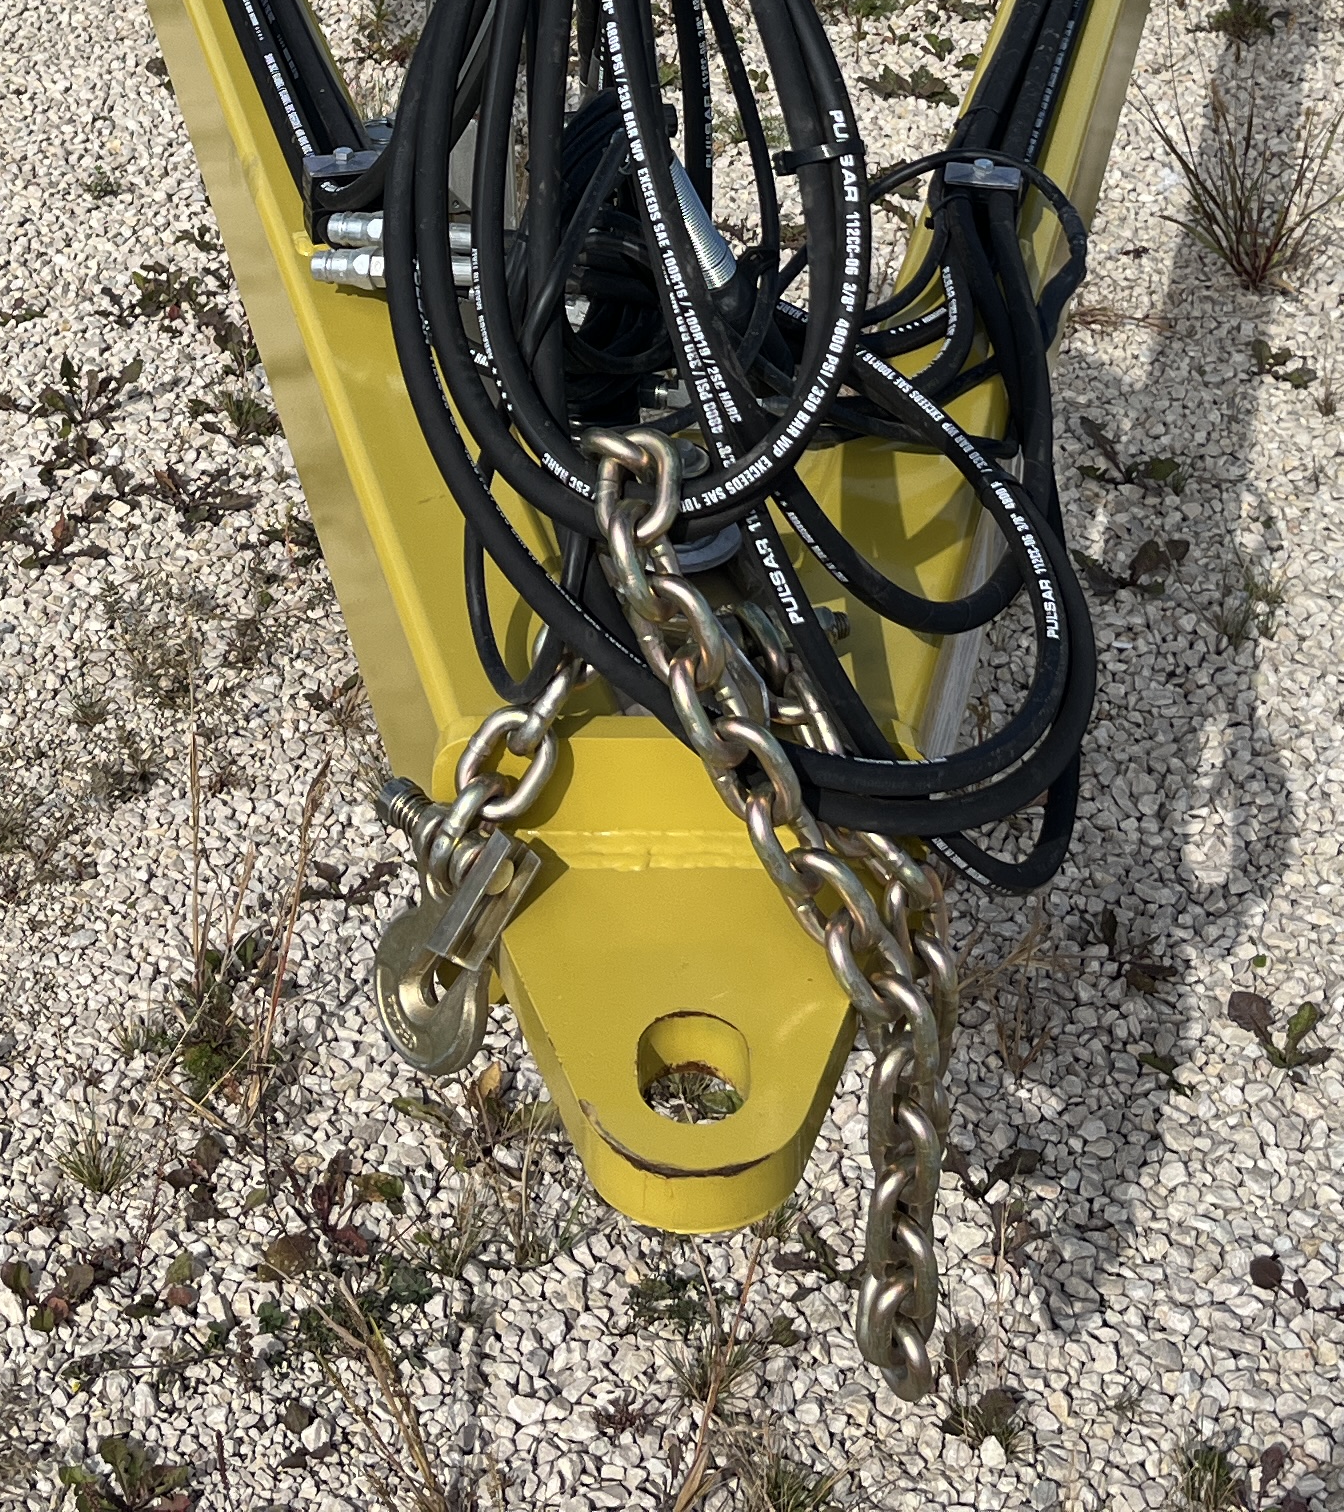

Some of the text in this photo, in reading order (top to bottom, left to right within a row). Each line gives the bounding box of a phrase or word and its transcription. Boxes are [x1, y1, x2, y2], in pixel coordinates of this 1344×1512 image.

[606, 21, 621, 54] 4800
[611, 53, 626, 76] PSI
[617, 84, 633, 111] 330
[623, 111, 639, 139] BAR
[629, 139, 645, 163] WP
[828, 109, 859, 203] PUSAR
[637, 166, 662, 222] EXCEEDS
[652, 222, 671, 249] SAE
[844, 211, 861, 276] 112CC-06
[662, 249, 689, 300] 100R16
[840, 282, 858, 313] 3/8"
[683, 308, 712, 357] 100R19
[828, 317, 851, 354] 4800
[683, 343, 703, 369] 330
[819, 353, 840, 379] PSI
[862, 352, 897, 380] 100R16
[694, 377, 713, 401] PSI
[706, 365, 727, 390] 2SC
[893, 376, 914, 394] SAE
[718, 389, 743, 424] HARC
[803, 384, 826, 413] 330
[908, 390, 945, 422] EXCEEDS
[703, 401, 724, 435] 4800
[786, 409, 811, 438] BAR
[772, 434, 794, 459] WP
[968, 451, 989, 469] 330
[568, 475, 591, 497] 2SC
[725, 455, 774, 495] EXCEEDS
[701, 486, 727, 507] SAE
[995, 487, 1016, 510] 4800
[1010, 513, 1029, 532] 3/8"
[1021, 533, 1047, 575] 112CC-06
[754, 537, 806, 625] PULSAR
[1038, 579, 1060, 640] PULSAR
